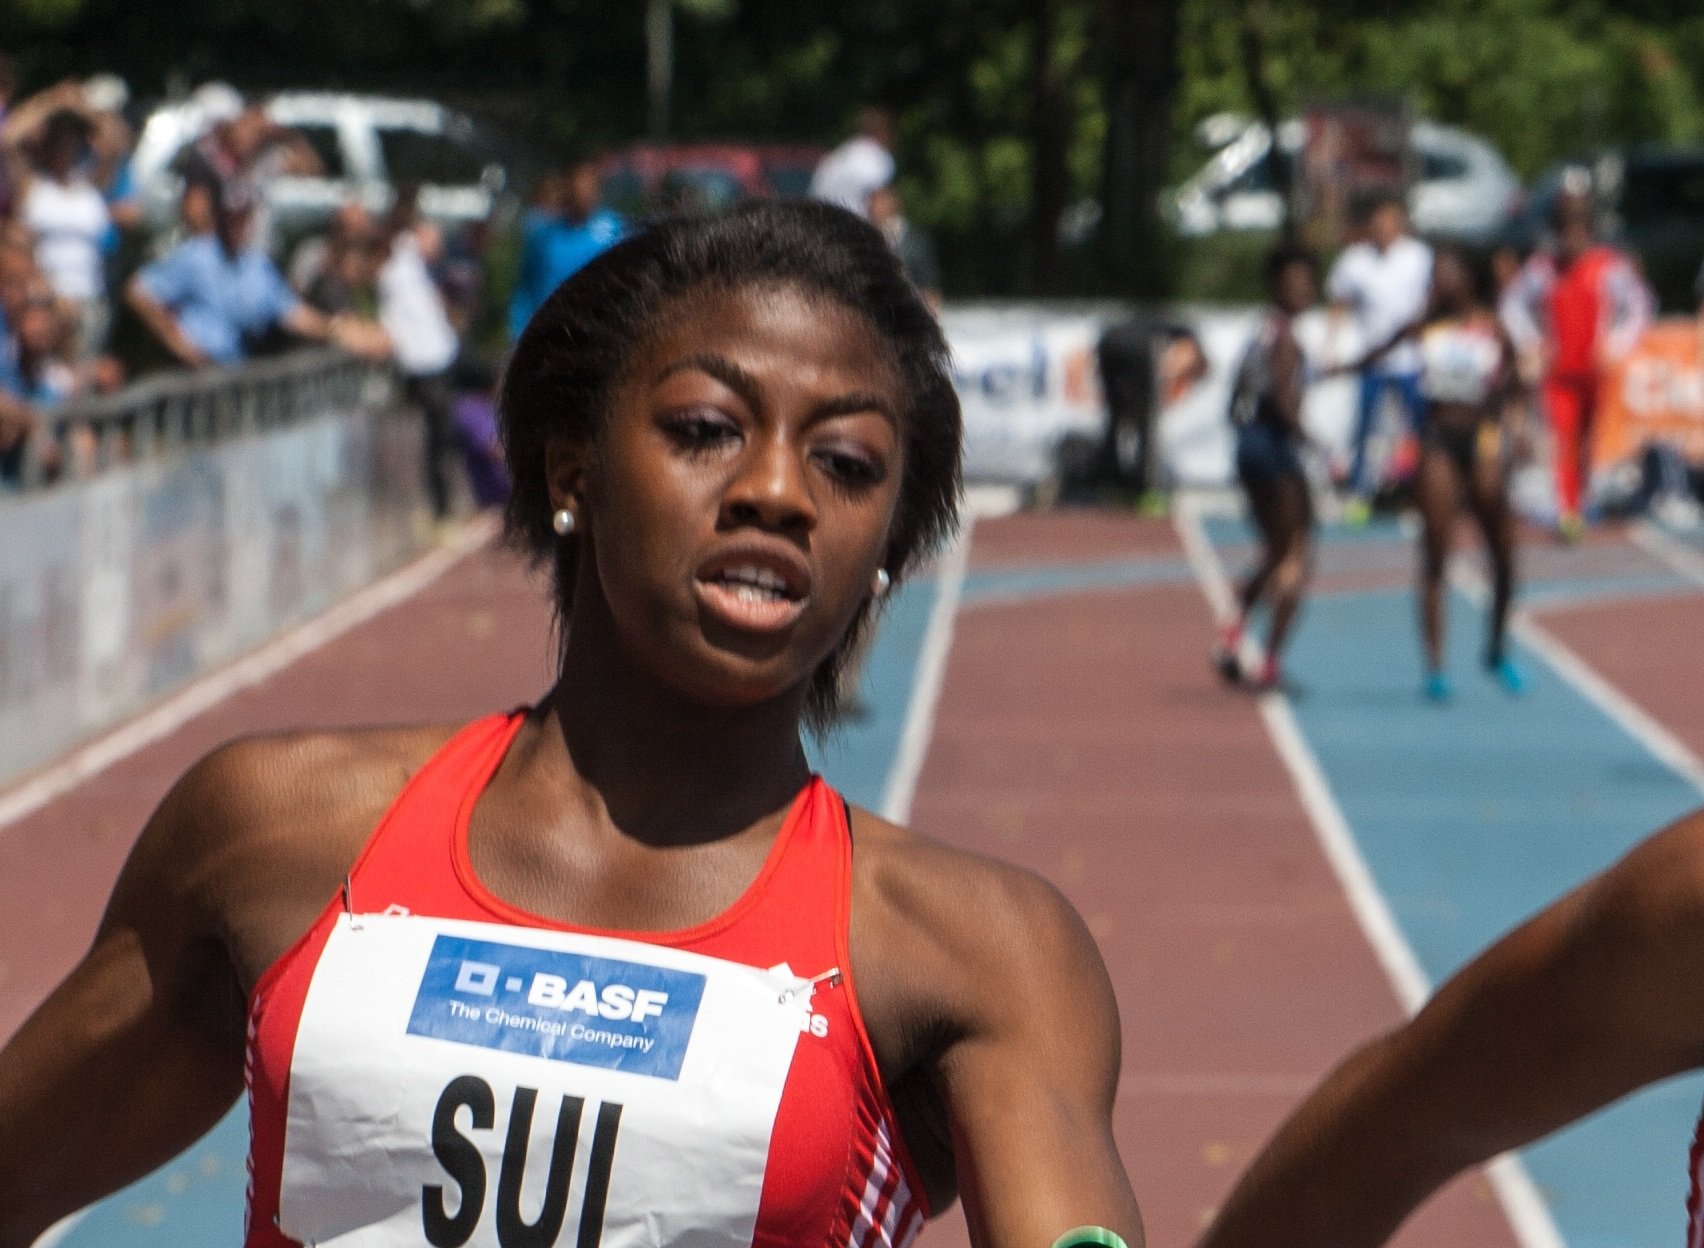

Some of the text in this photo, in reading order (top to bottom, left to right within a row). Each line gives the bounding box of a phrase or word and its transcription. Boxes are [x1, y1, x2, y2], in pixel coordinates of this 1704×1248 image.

[528, 971, 669, 1023] BASF
[449, 999, 655, 1054] The Chemical Company
